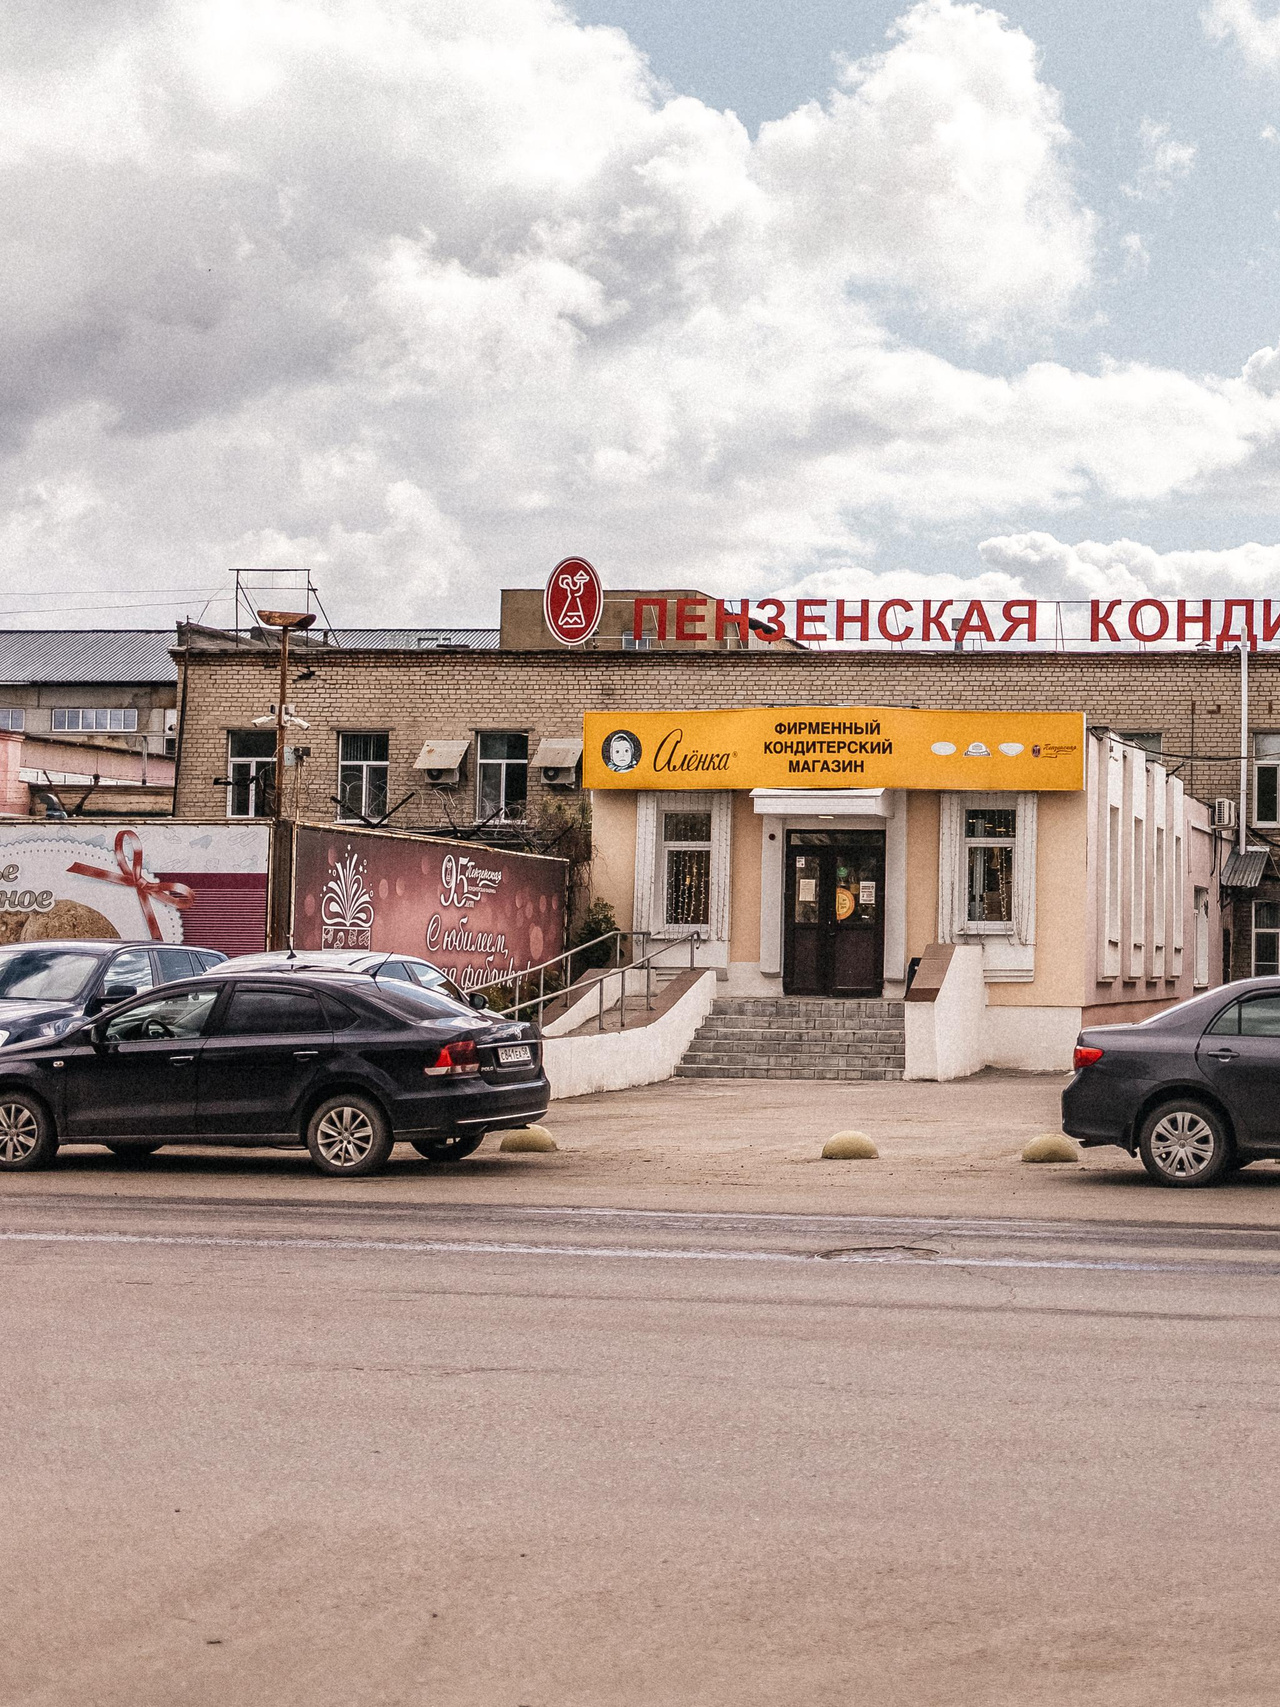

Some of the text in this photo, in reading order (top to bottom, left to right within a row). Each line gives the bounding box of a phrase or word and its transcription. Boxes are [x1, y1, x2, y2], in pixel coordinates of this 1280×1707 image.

[633, 597, 1037, 643] ПЕНЗЕНСКАЯ
[774, 719, 881, 735] ФИРМЕННЫЙ
[764, 739, 893, 756] КОНДИТЕРСКИЙ
[788, 760, 864, 773] МАГАЗИН
